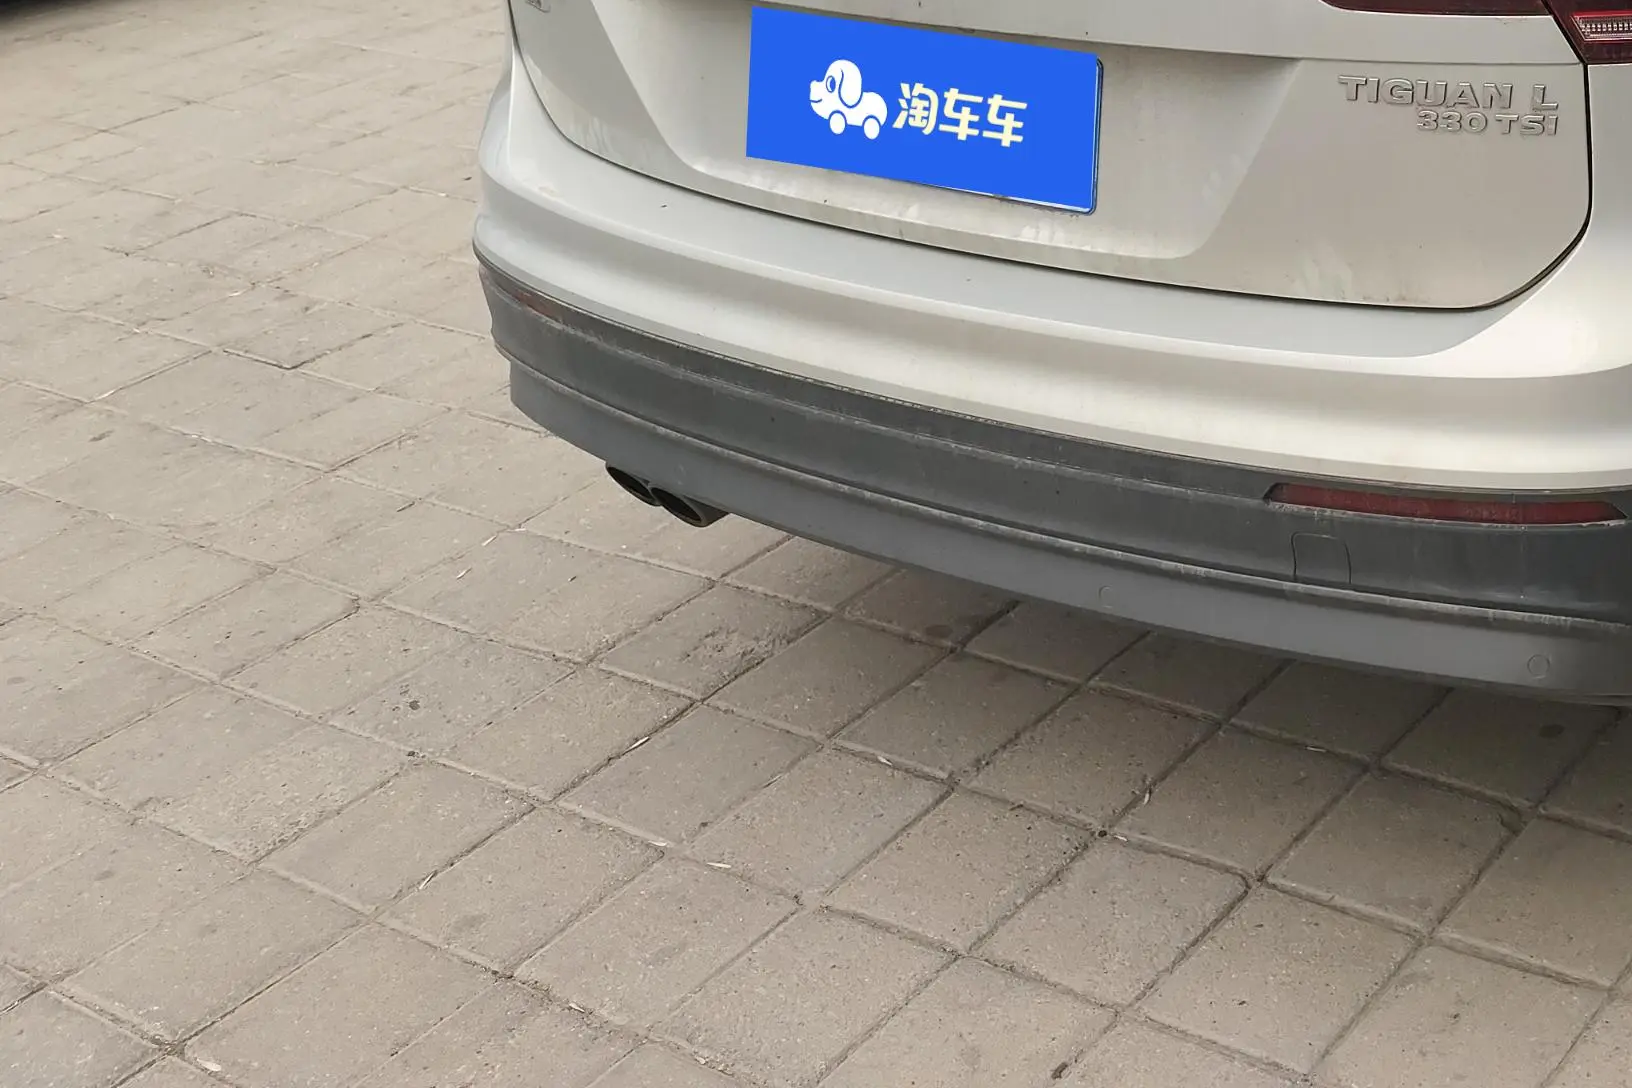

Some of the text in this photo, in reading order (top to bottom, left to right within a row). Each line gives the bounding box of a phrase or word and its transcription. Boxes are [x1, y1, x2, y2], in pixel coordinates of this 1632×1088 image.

[1338, 74, 1559, 111] TIGUAN L
[1416, 109, 1558, 136] 330 TSI
